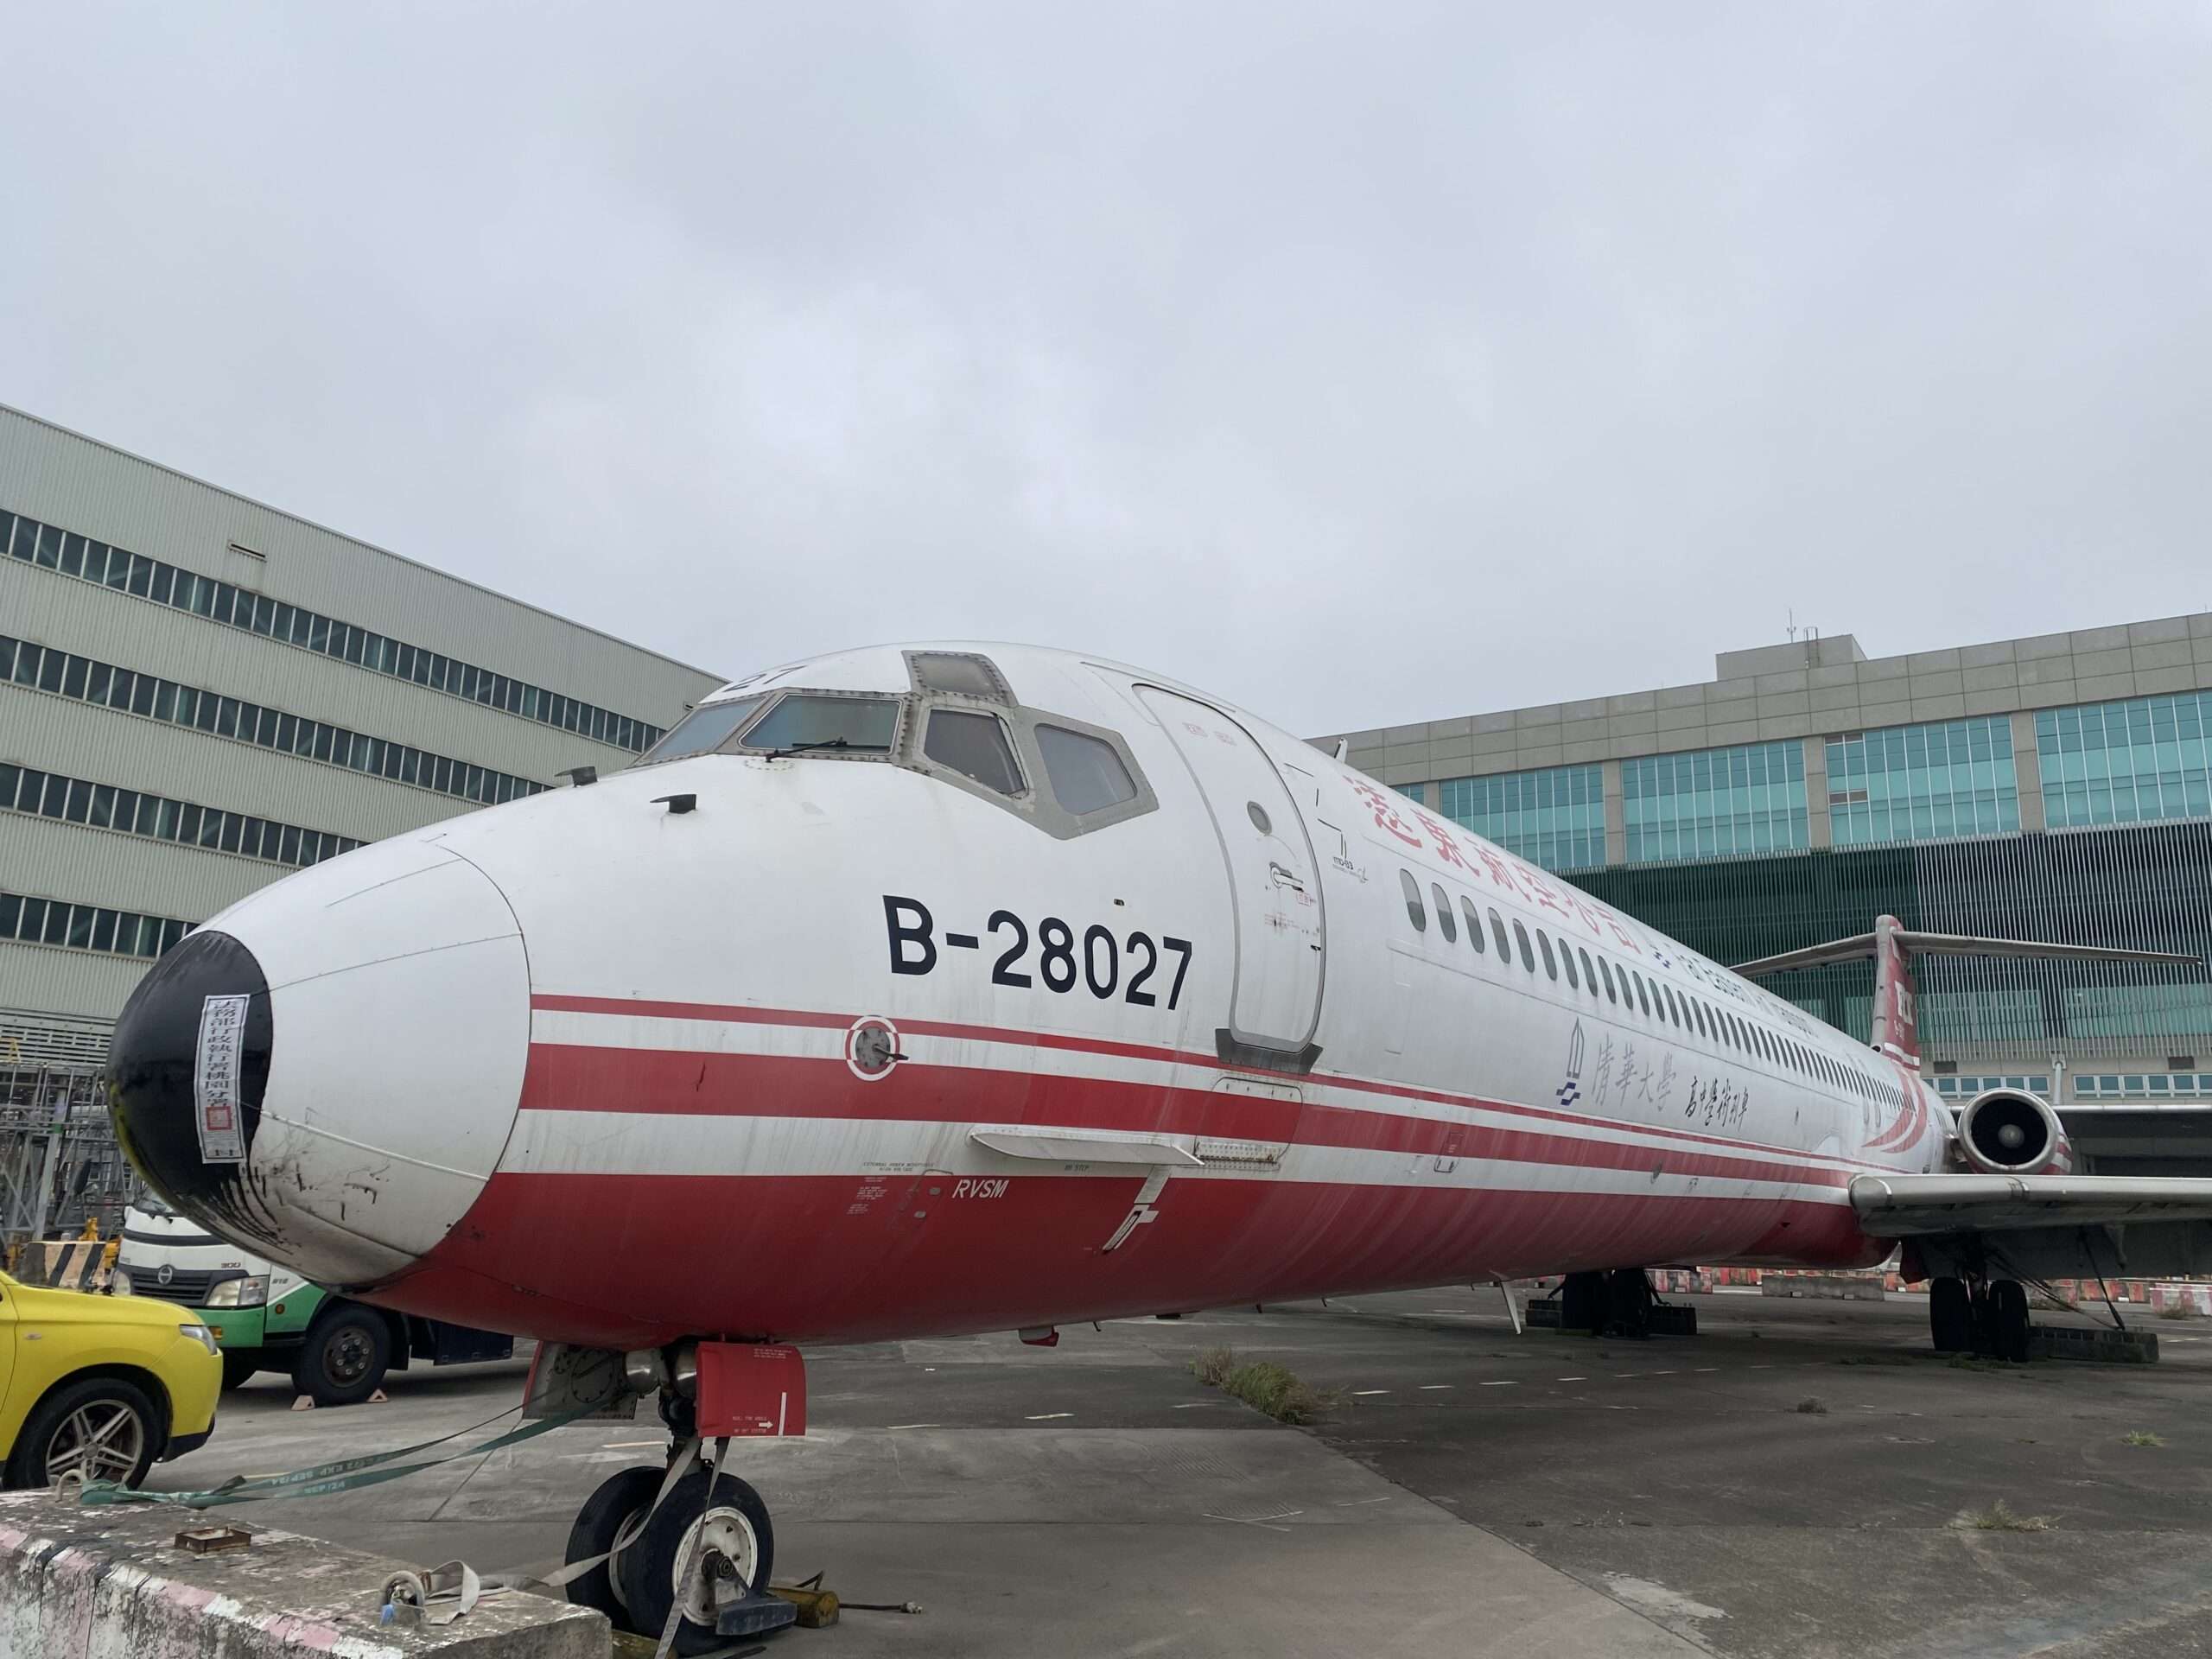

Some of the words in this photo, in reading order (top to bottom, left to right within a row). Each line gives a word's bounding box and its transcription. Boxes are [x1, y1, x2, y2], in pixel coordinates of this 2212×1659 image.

[882, 894, 1192, 1010] B-28027
[1592, 1030, 1676, 1112] 清華大學
[952, 1179, 1009, 1198] RVSM
